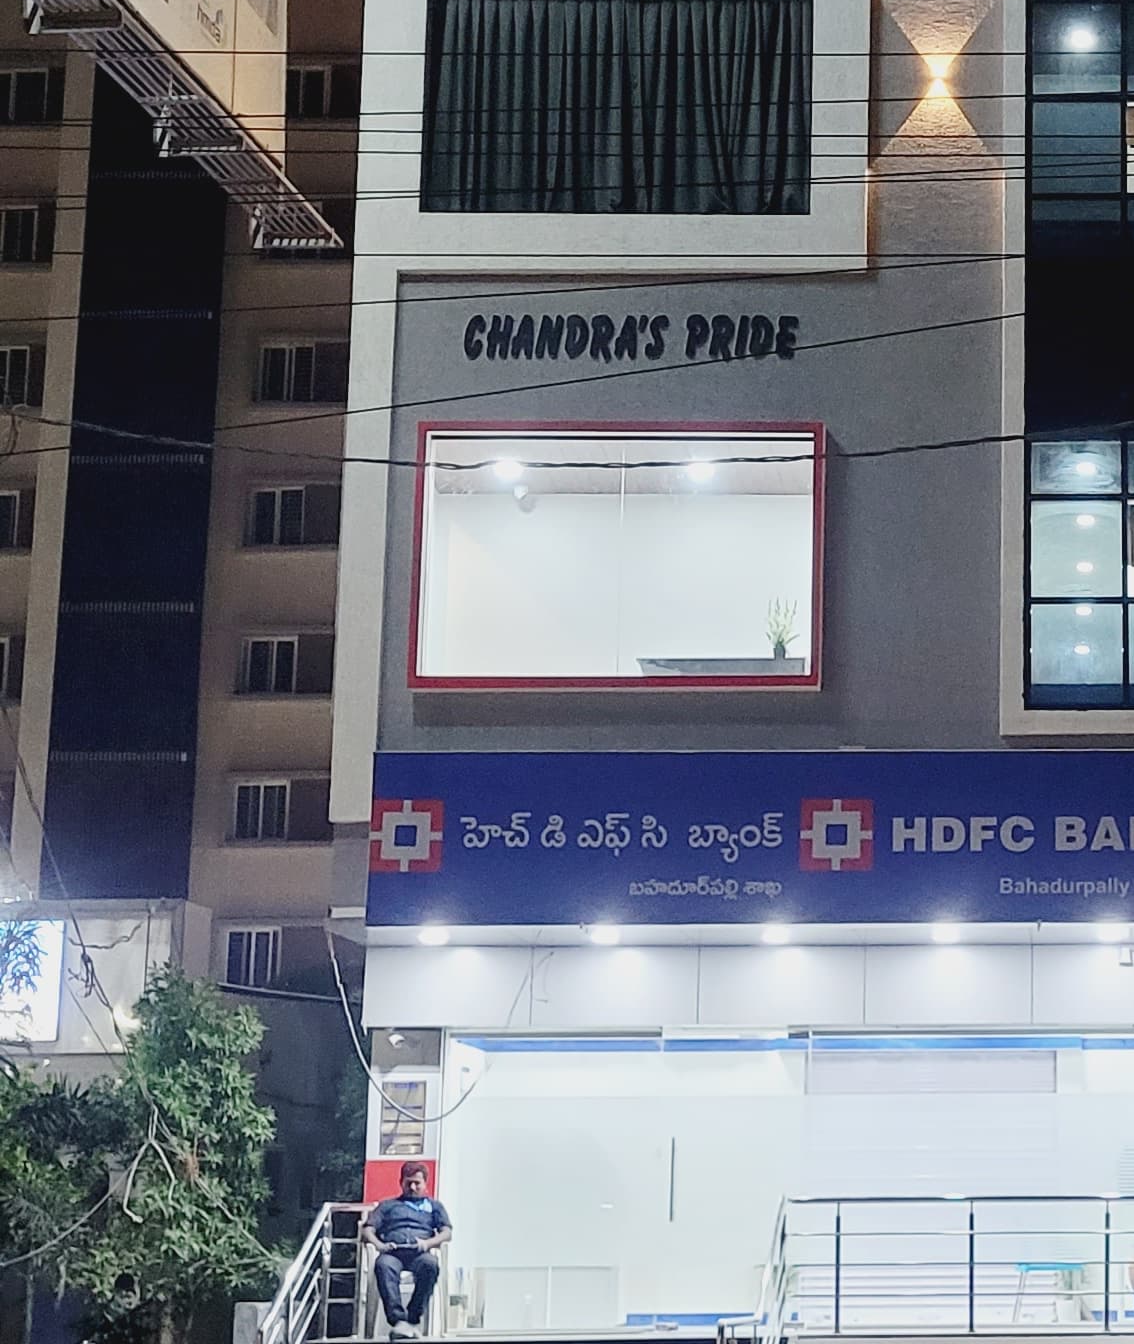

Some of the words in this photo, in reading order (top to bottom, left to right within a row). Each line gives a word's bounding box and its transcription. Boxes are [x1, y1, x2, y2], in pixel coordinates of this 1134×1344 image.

[464, 314, 670, 363] CHANDRA'S
[685, 314, 799, 362] PRIDE
[641, 815, 668, 848] సి
[892, 815, 1035, 852] HDFC
[1000, 877, 1130, 897] Bahadurpally
